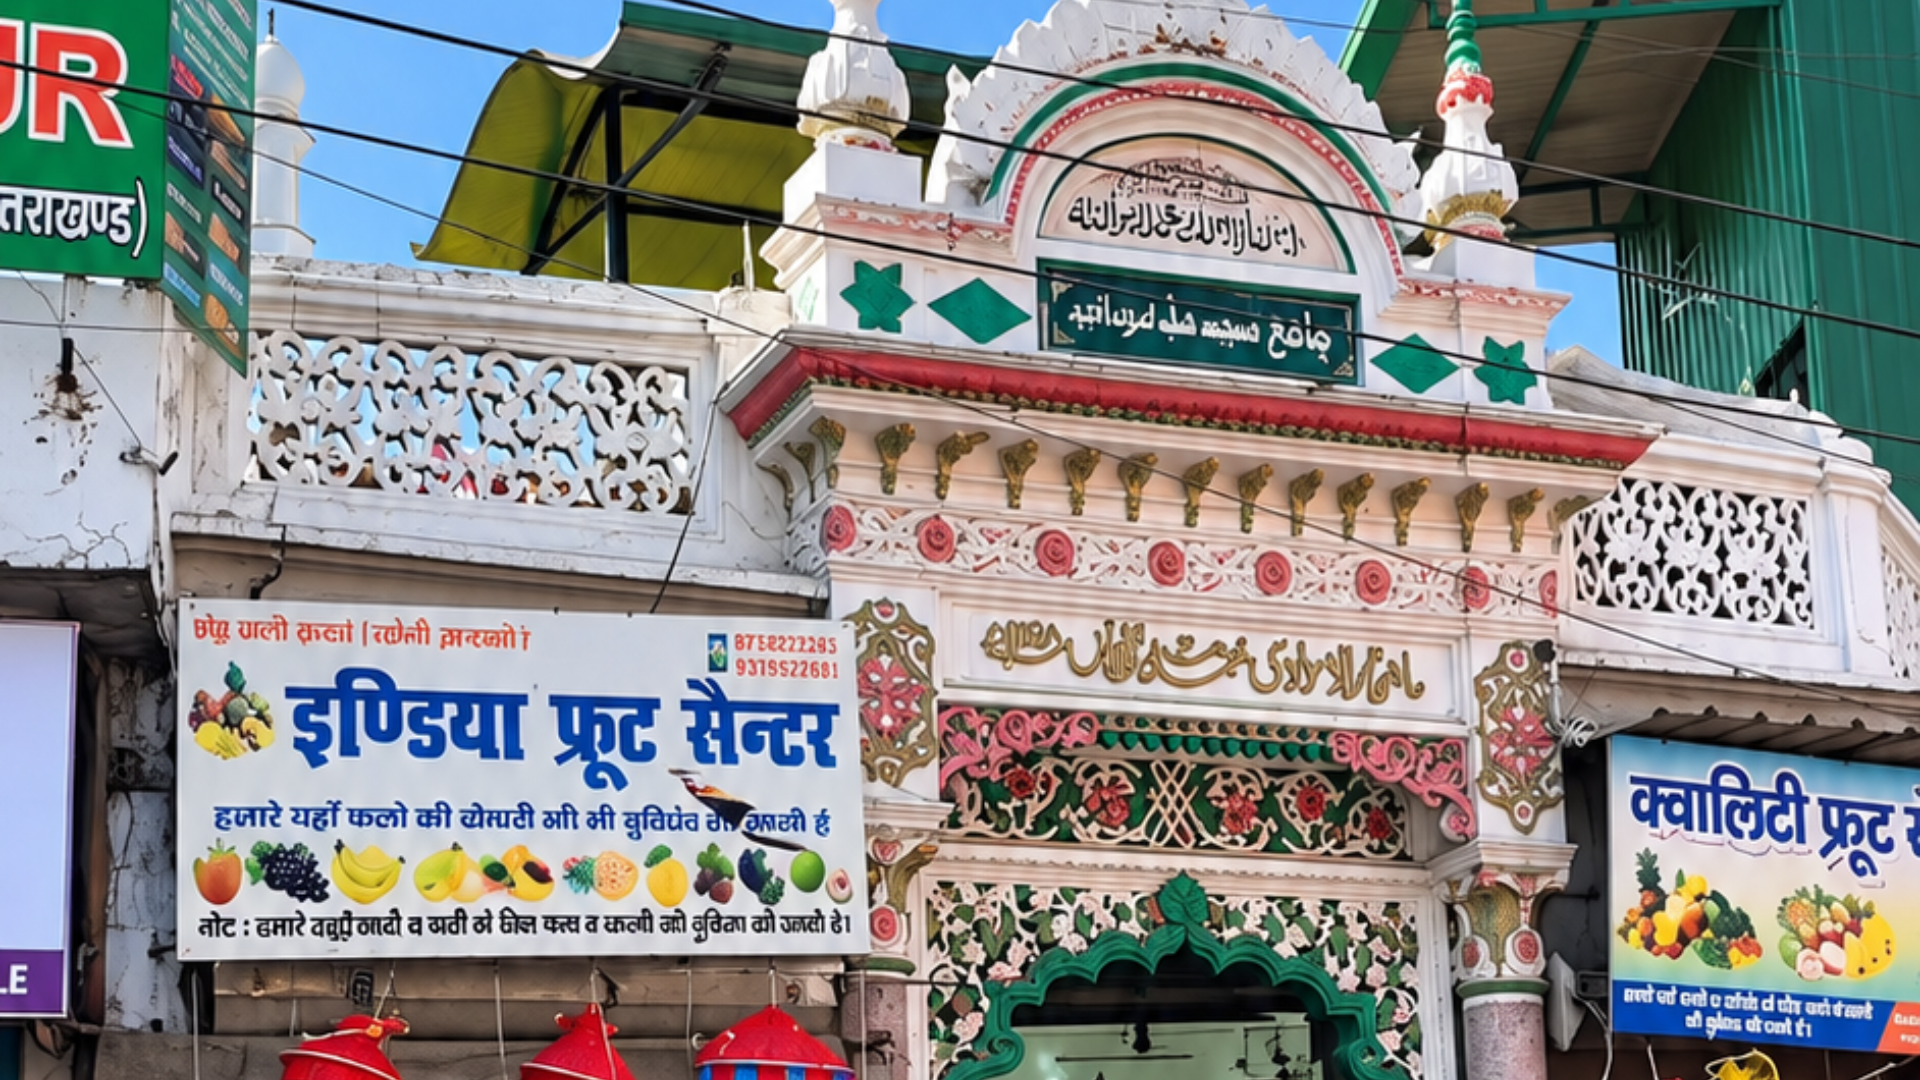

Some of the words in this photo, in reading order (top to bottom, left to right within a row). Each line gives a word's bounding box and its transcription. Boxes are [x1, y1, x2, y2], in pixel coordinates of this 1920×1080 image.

[285, 667, 529, 769] इण्डिया
[548, 695, 661, 791] फ्रूट
[680, 678, 840, 768] सैन्टर
[1630, 764, 1810, 845] क्वालिटी
[1818, 797, 1896, 877] फ्रूट
[198, 910, 236, 938] नोट
